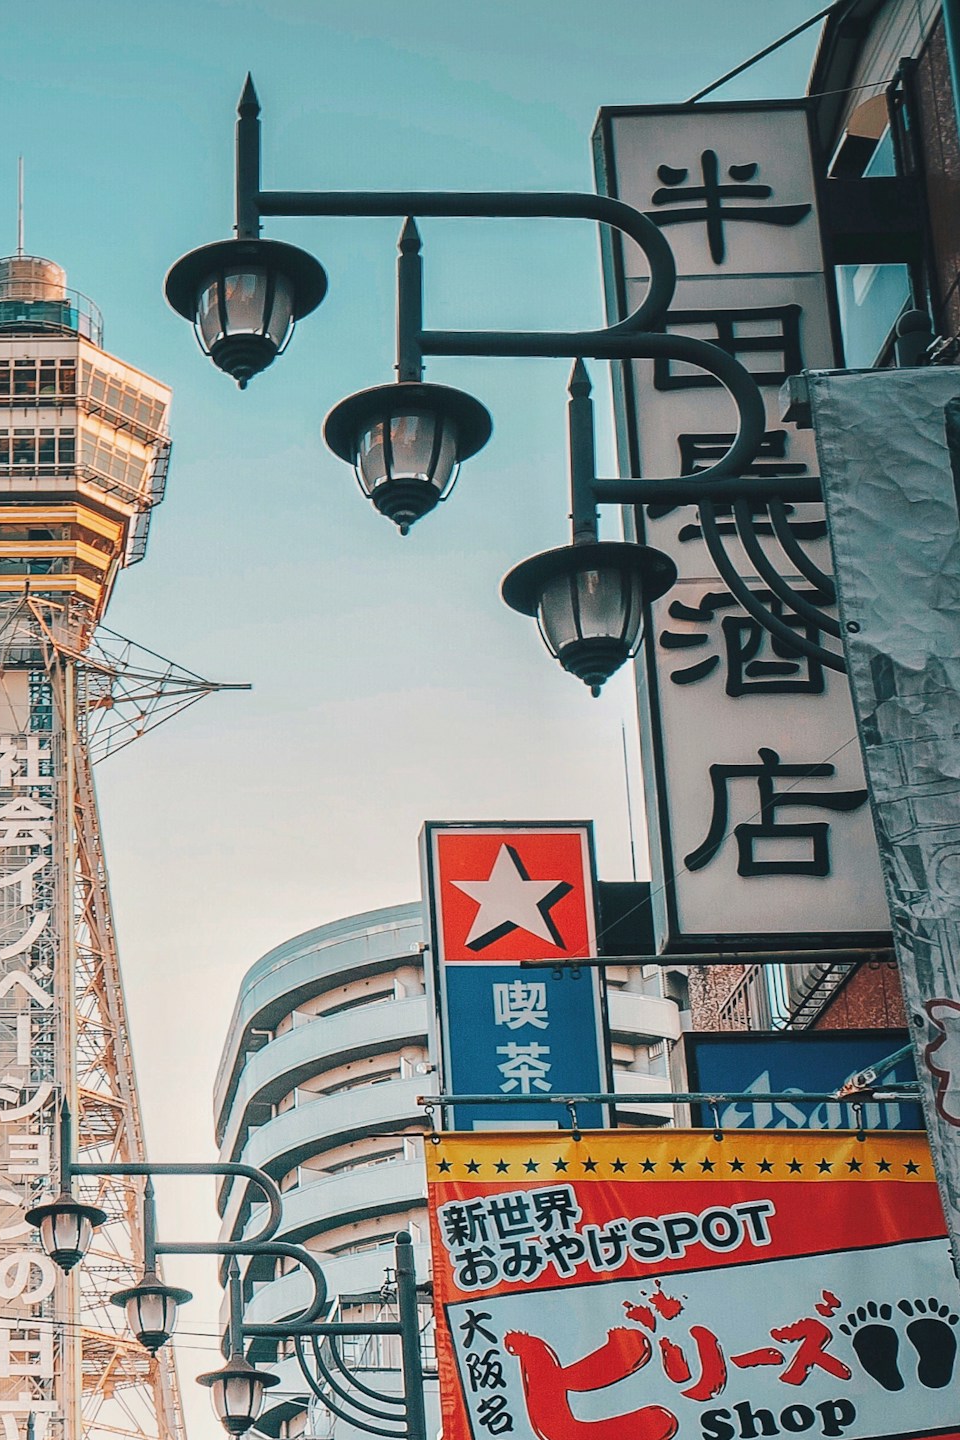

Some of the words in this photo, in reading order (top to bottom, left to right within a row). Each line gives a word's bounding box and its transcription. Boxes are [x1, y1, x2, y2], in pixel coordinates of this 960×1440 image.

[492, 979, 553, 1095] 喫茶
[443, 1187, 578, 1247] 新世界
[457, 1204, 771, 1288] おみやげSPOT
